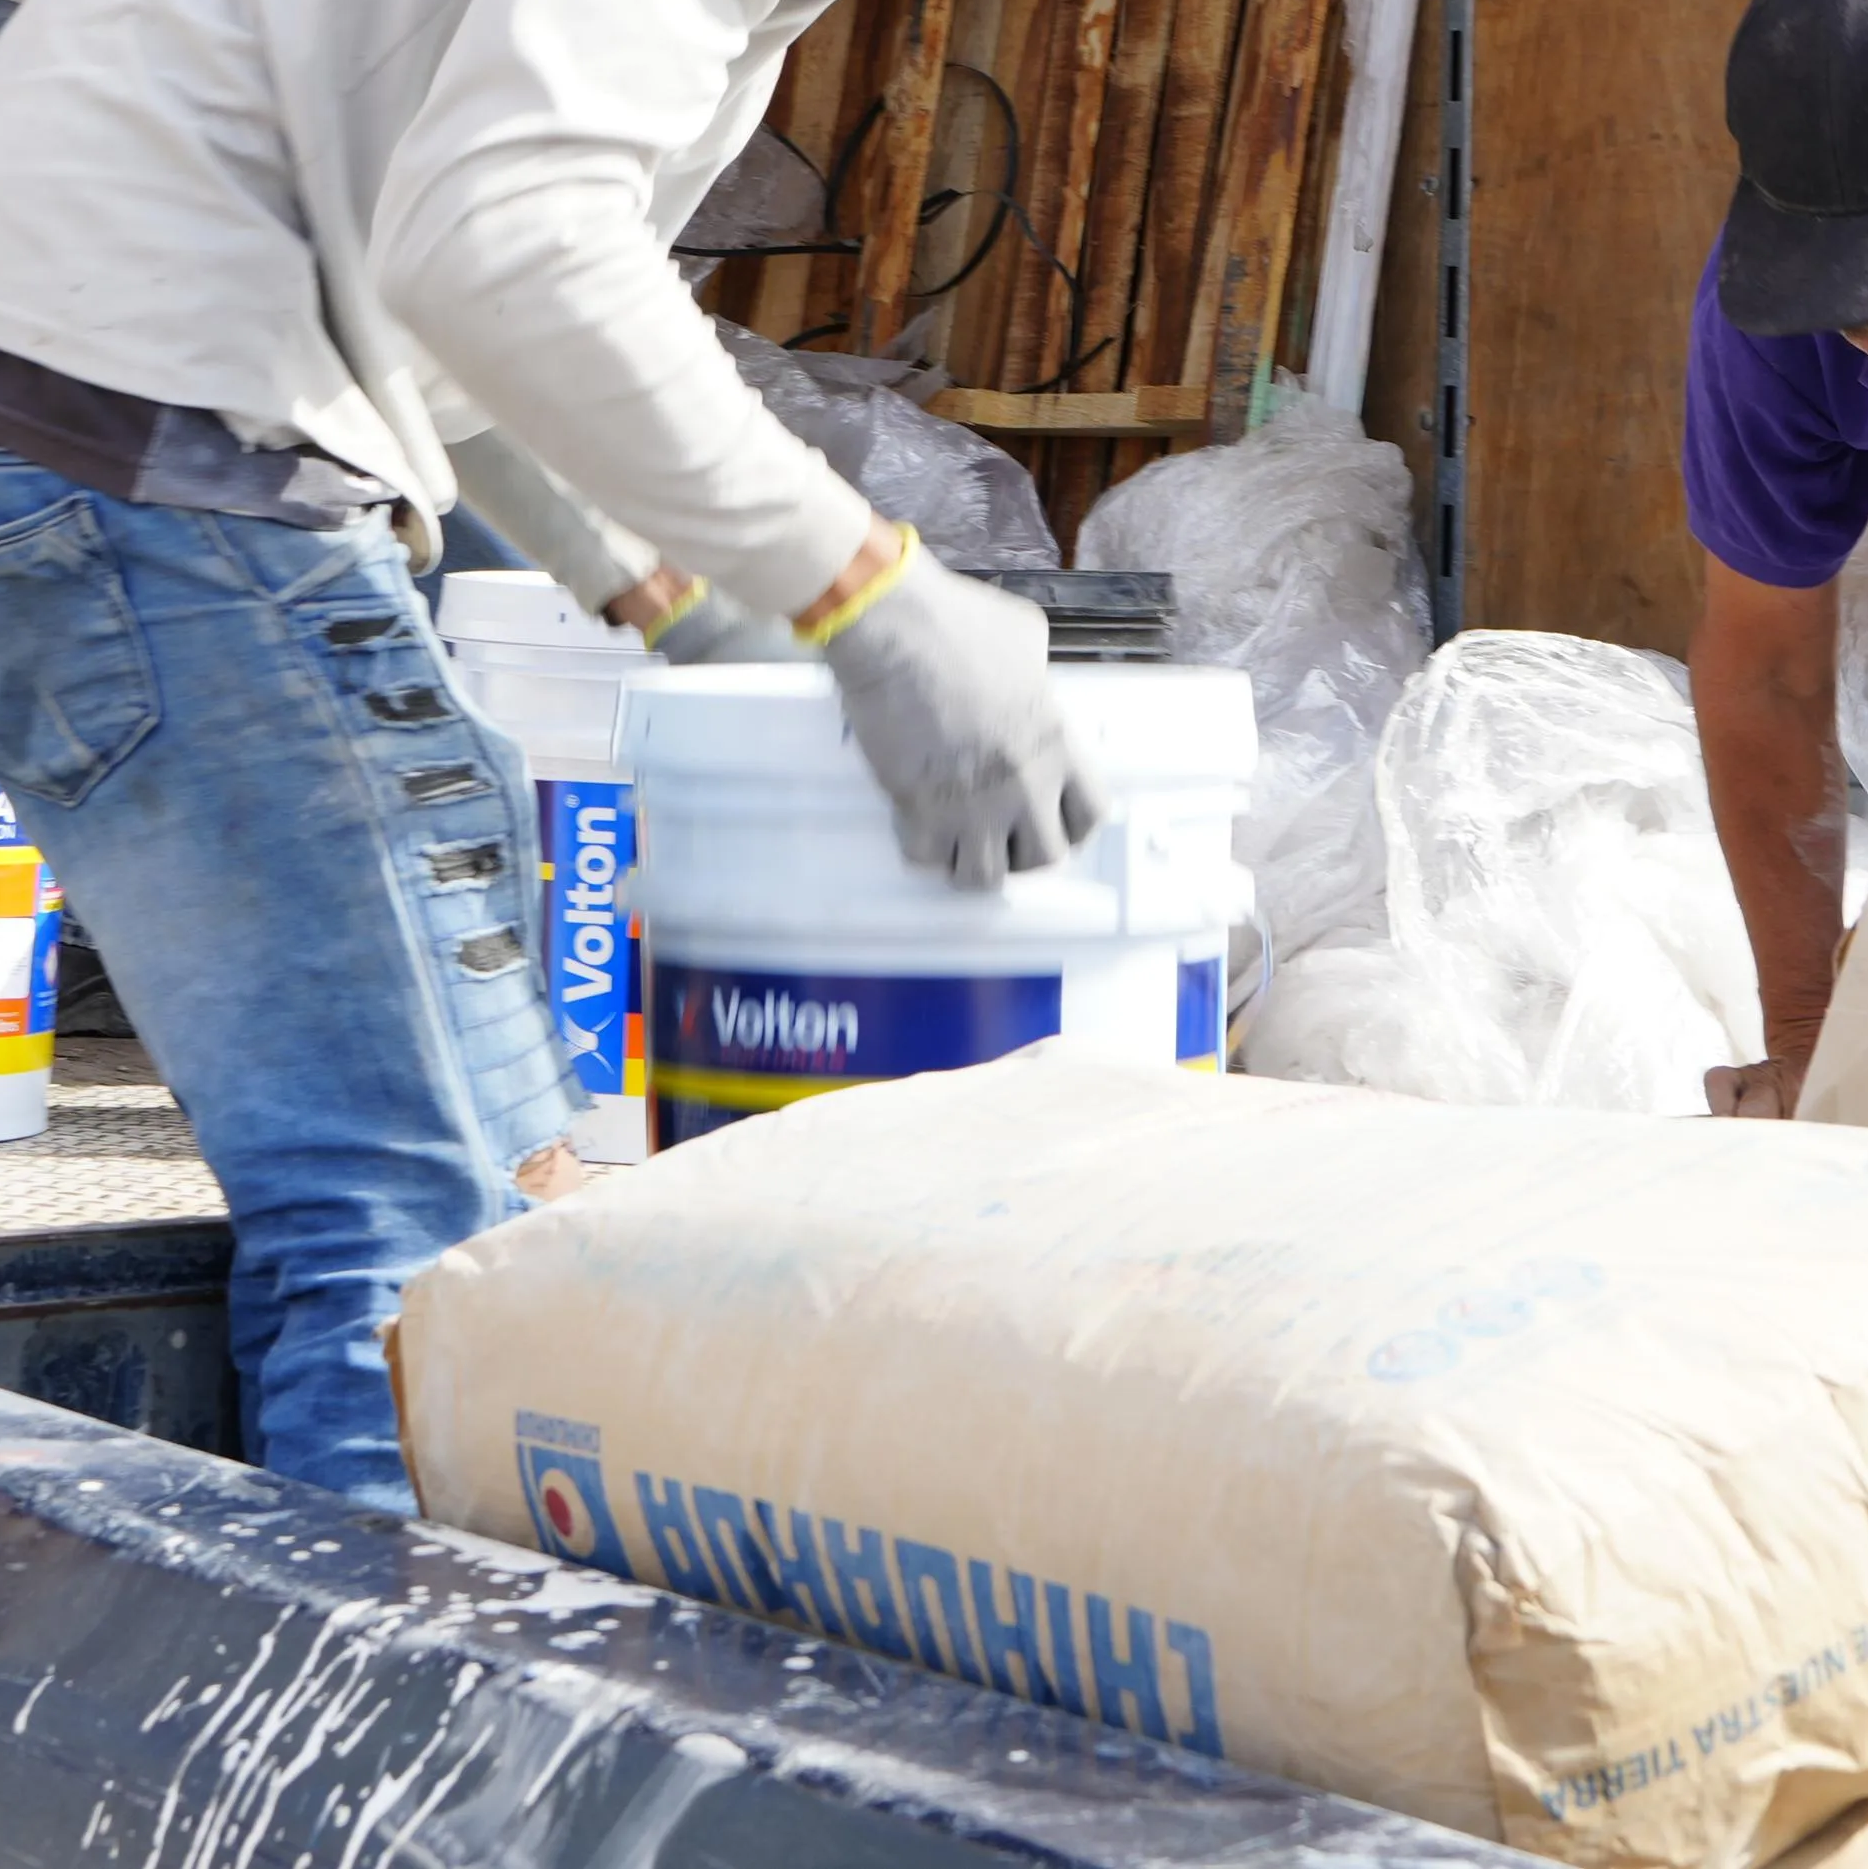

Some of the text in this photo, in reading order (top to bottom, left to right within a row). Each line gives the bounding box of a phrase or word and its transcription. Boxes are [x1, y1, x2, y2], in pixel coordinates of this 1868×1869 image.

[562, 806, 618, 1003] Volton
[712, 984, 859, 1054] Volton
[634, 1470, 1225, 1760] CHIHUAHUA
[1541, 1738, 1687, 1822] TIERRA
